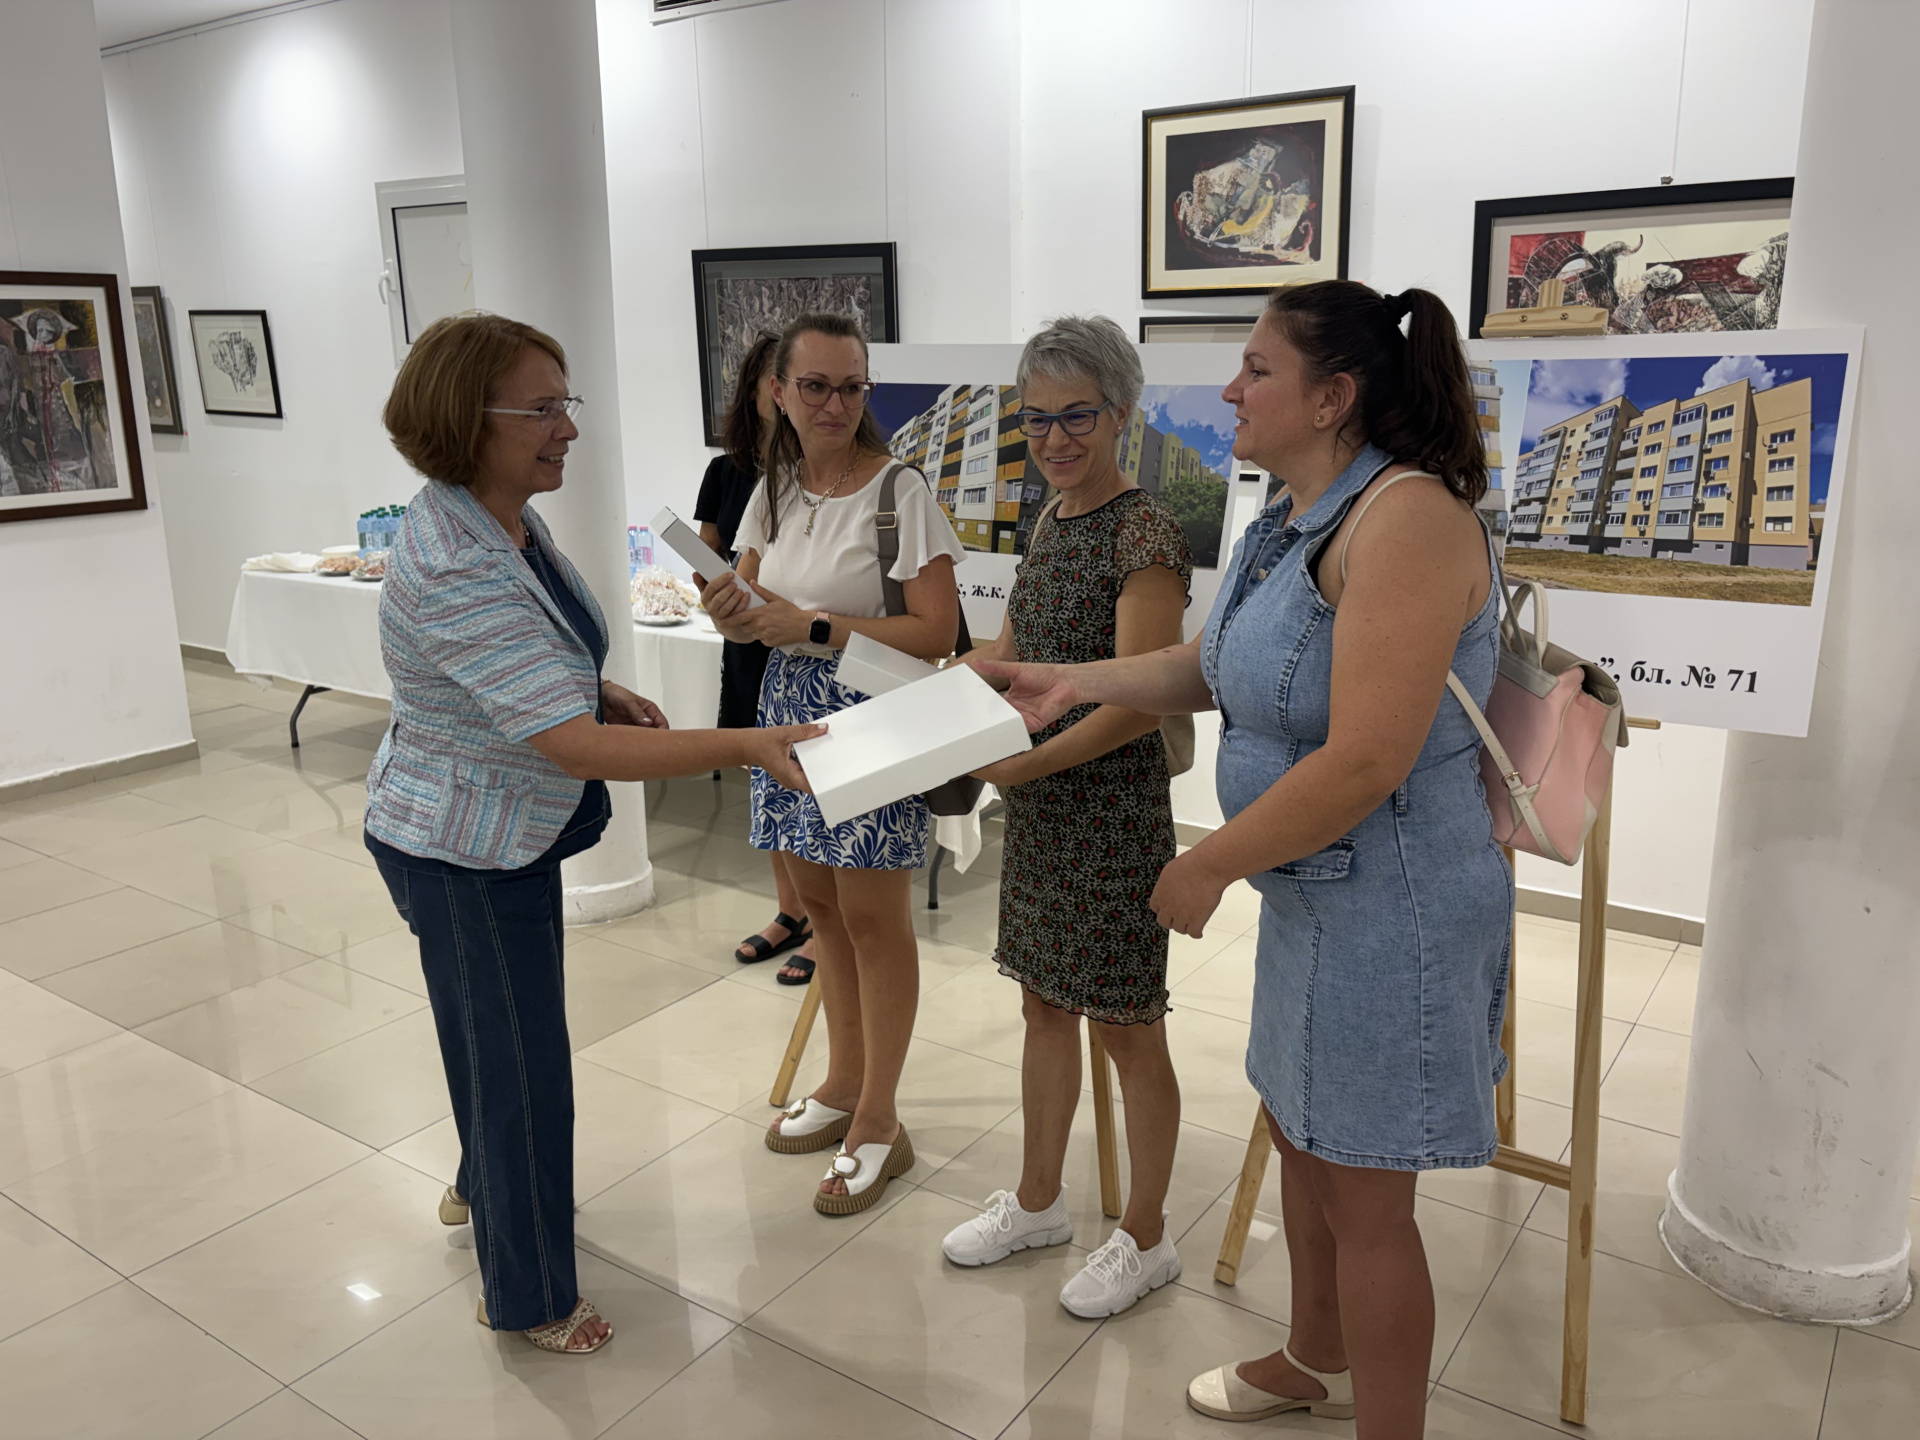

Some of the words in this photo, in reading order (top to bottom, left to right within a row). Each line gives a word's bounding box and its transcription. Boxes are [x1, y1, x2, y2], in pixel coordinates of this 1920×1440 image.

[971, 584, 1006, 600] ж.к.
[1630, 660, 1672, 685] бл.
[1680, 664, 1716, 689] №
[1726, 668, 1758, 694] 71
